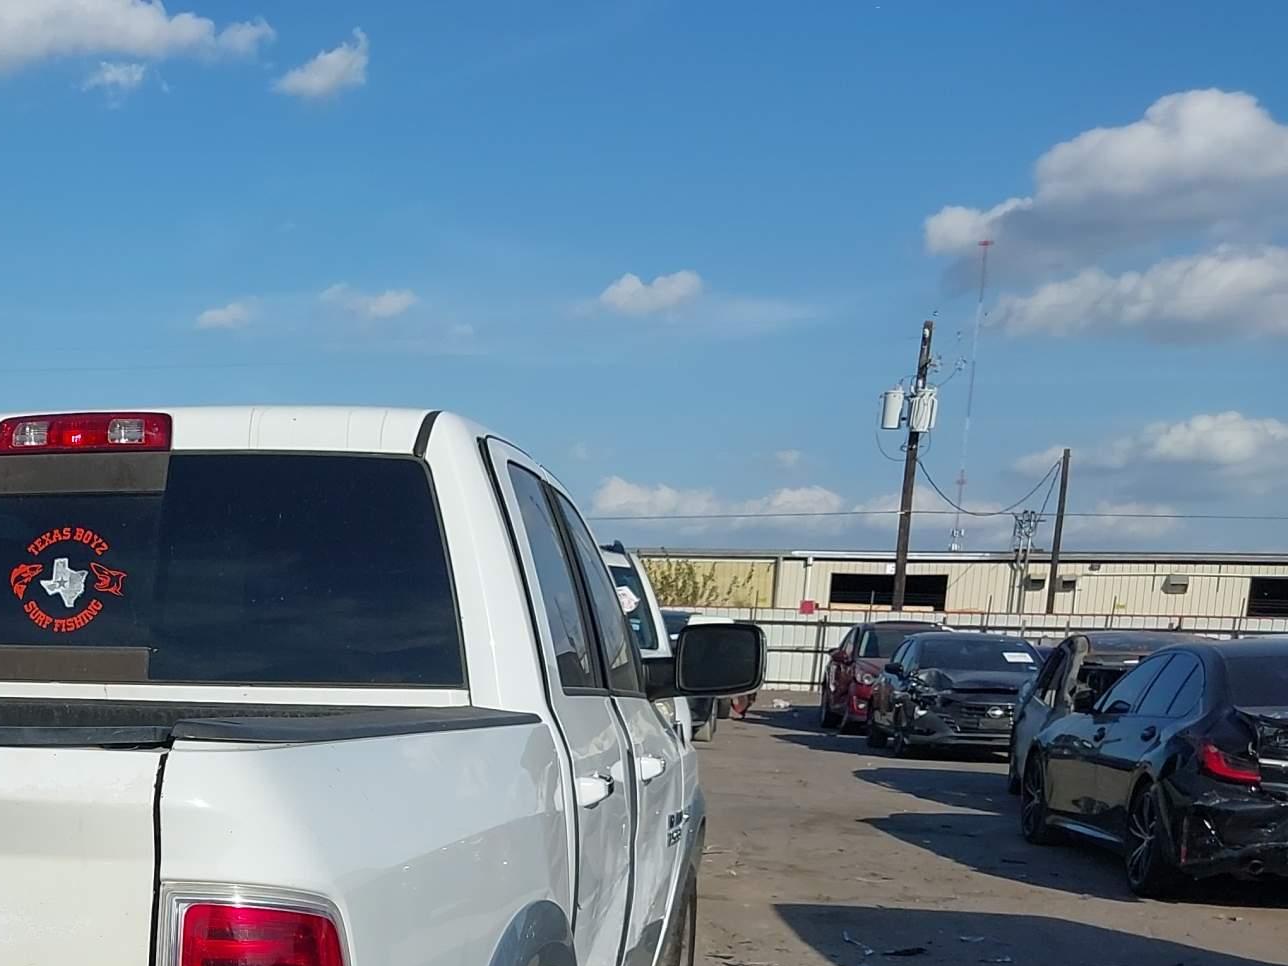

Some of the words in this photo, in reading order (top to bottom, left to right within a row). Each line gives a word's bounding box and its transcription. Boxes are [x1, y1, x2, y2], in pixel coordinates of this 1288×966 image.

[27, 527, 72, 556] TEXAS
[73, 527, 111, 557] BOYZ
[23, 600, 54, 629] SURF
[52, 599, 104, 633] FISHING
